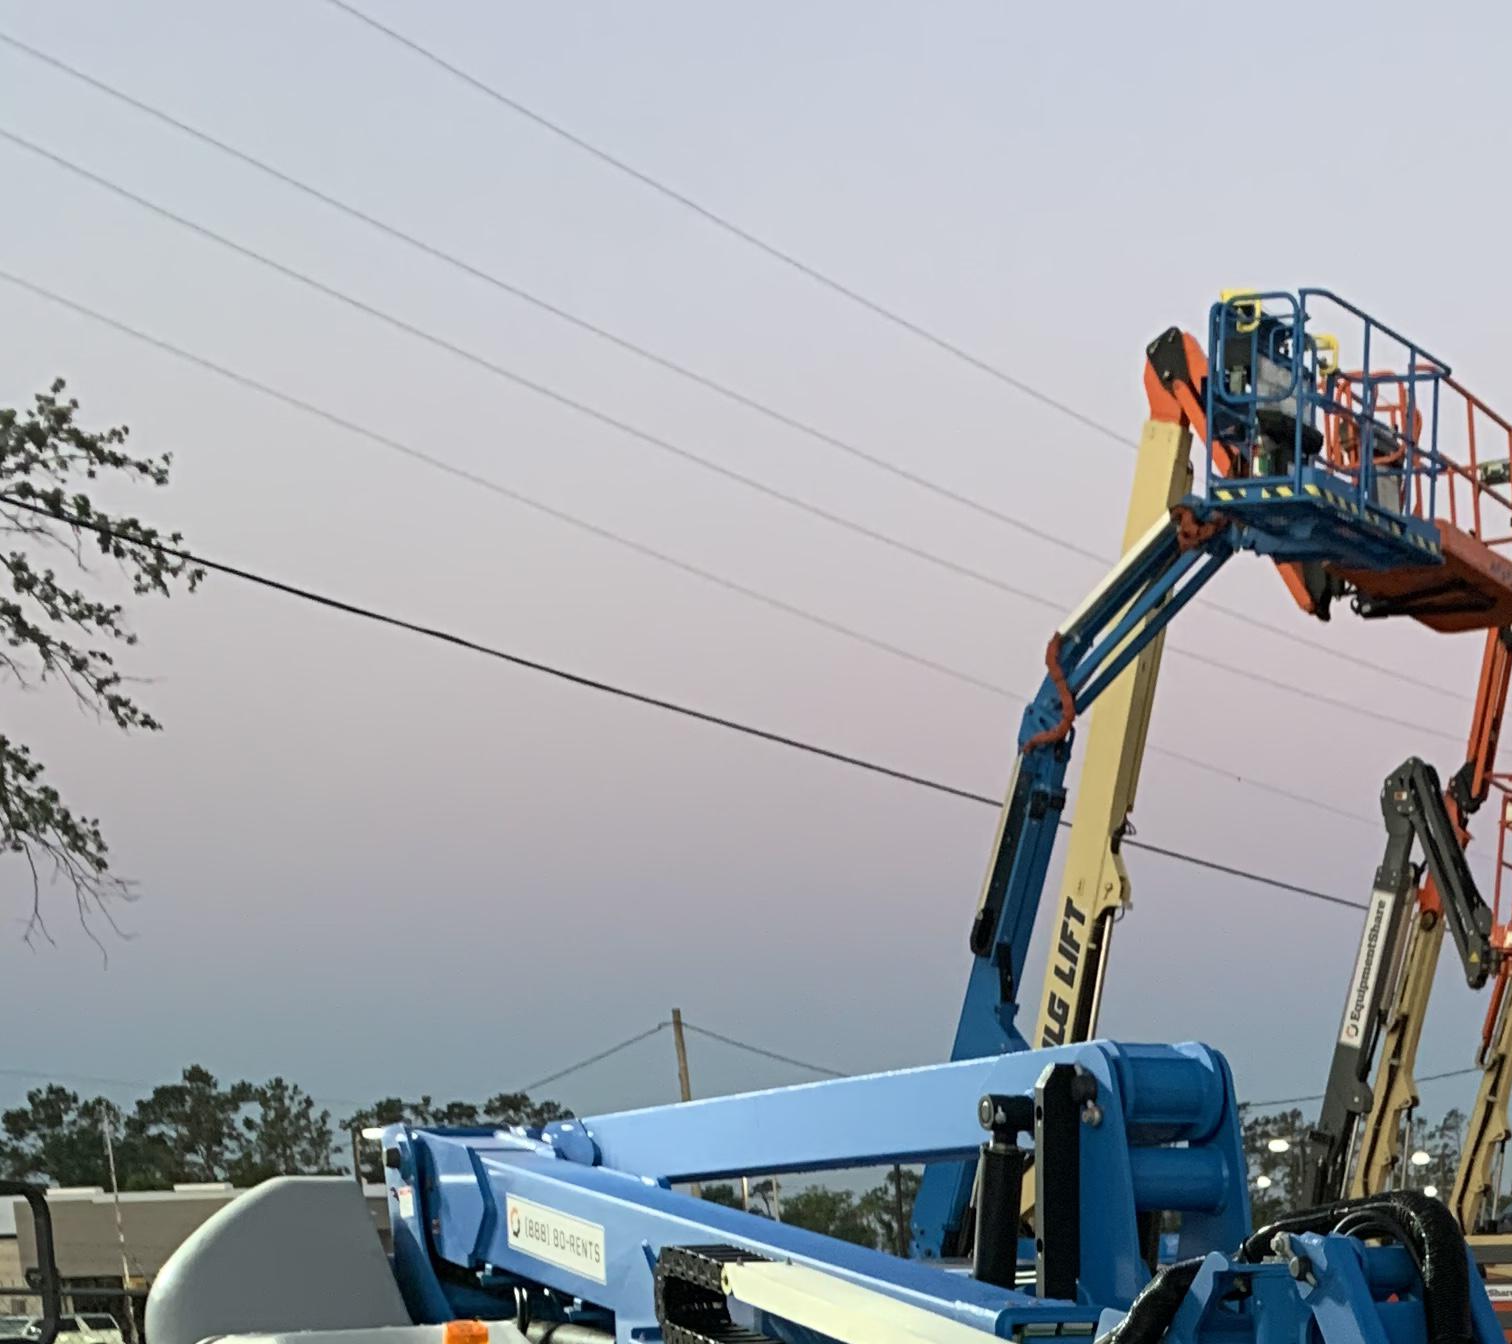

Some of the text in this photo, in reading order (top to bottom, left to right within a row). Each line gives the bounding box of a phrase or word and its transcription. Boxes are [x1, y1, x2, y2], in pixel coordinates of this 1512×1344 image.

[1054, 896, 1085, 988] LIFT
[1350, 899, 1387, 1024] EquipmentShare
[553, 1227, 601, 1264] 80-RENTS
